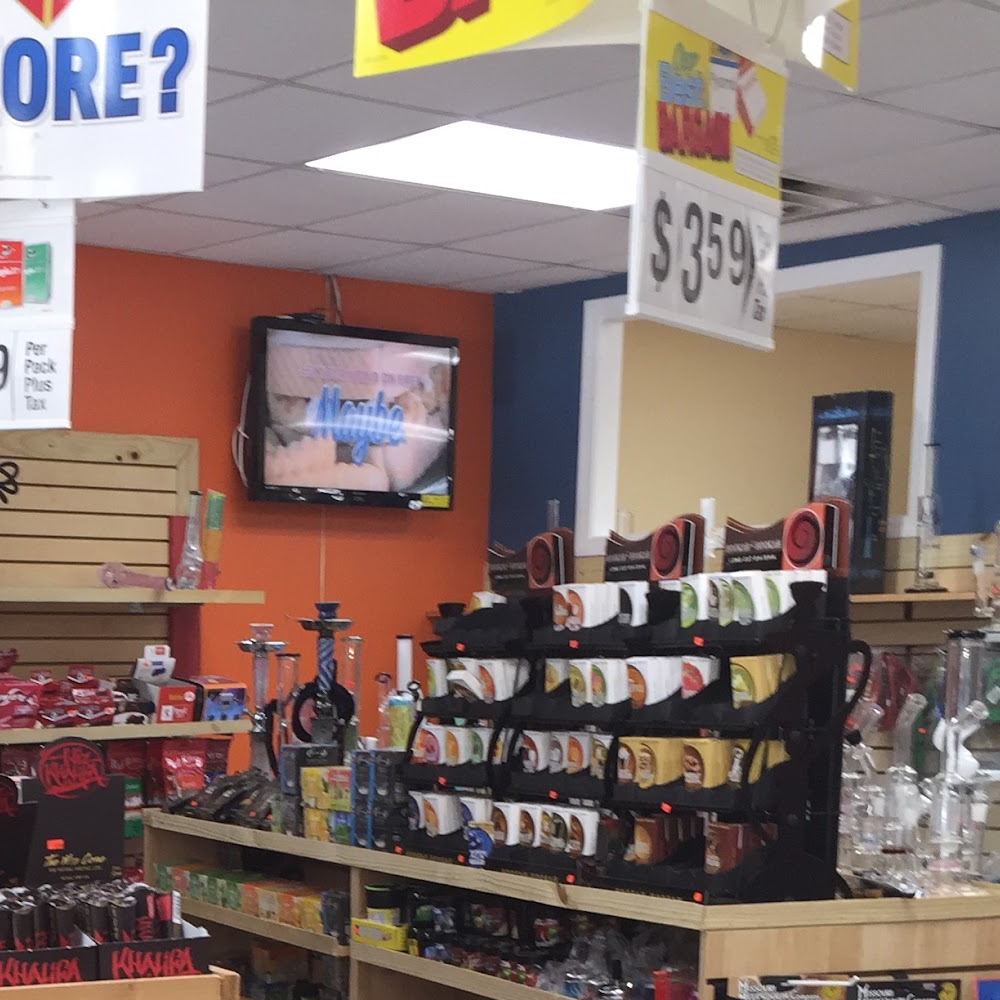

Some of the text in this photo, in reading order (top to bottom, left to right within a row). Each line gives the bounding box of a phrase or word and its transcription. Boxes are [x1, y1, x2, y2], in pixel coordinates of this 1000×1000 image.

[26, 341, 48, 356] Per
[24, 359, 57, 375] Pack
[24, 377, 53, 393] Plus
[24, 395, 47, 411] Tax
